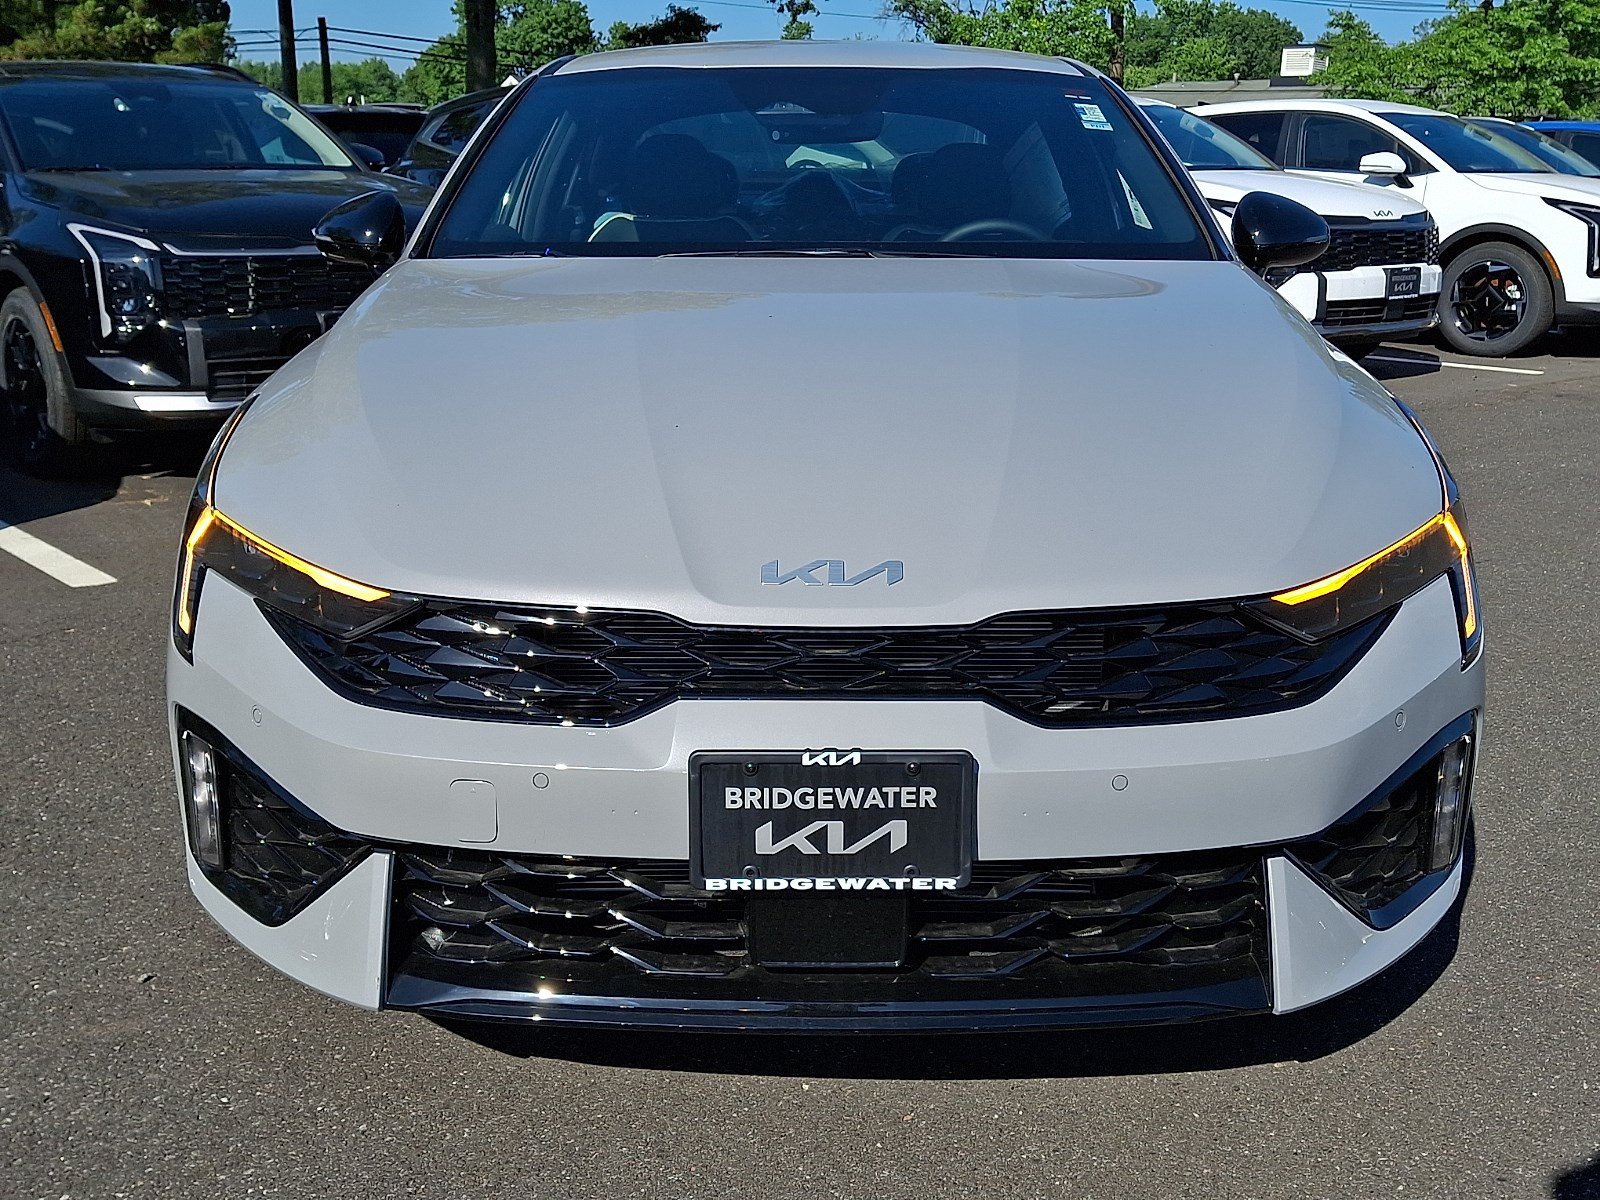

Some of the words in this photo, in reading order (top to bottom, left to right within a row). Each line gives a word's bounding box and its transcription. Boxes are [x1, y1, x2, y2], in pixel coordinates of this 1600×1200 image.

[761, 559, 904, 586] KIA
[802, 751, 861, 766] KIA
[725, 787, 937, 809] BRIDGEWATER
[755, 819, 908, 854] KIA
[705, 877, 957, 891] BRIDGEWATER
